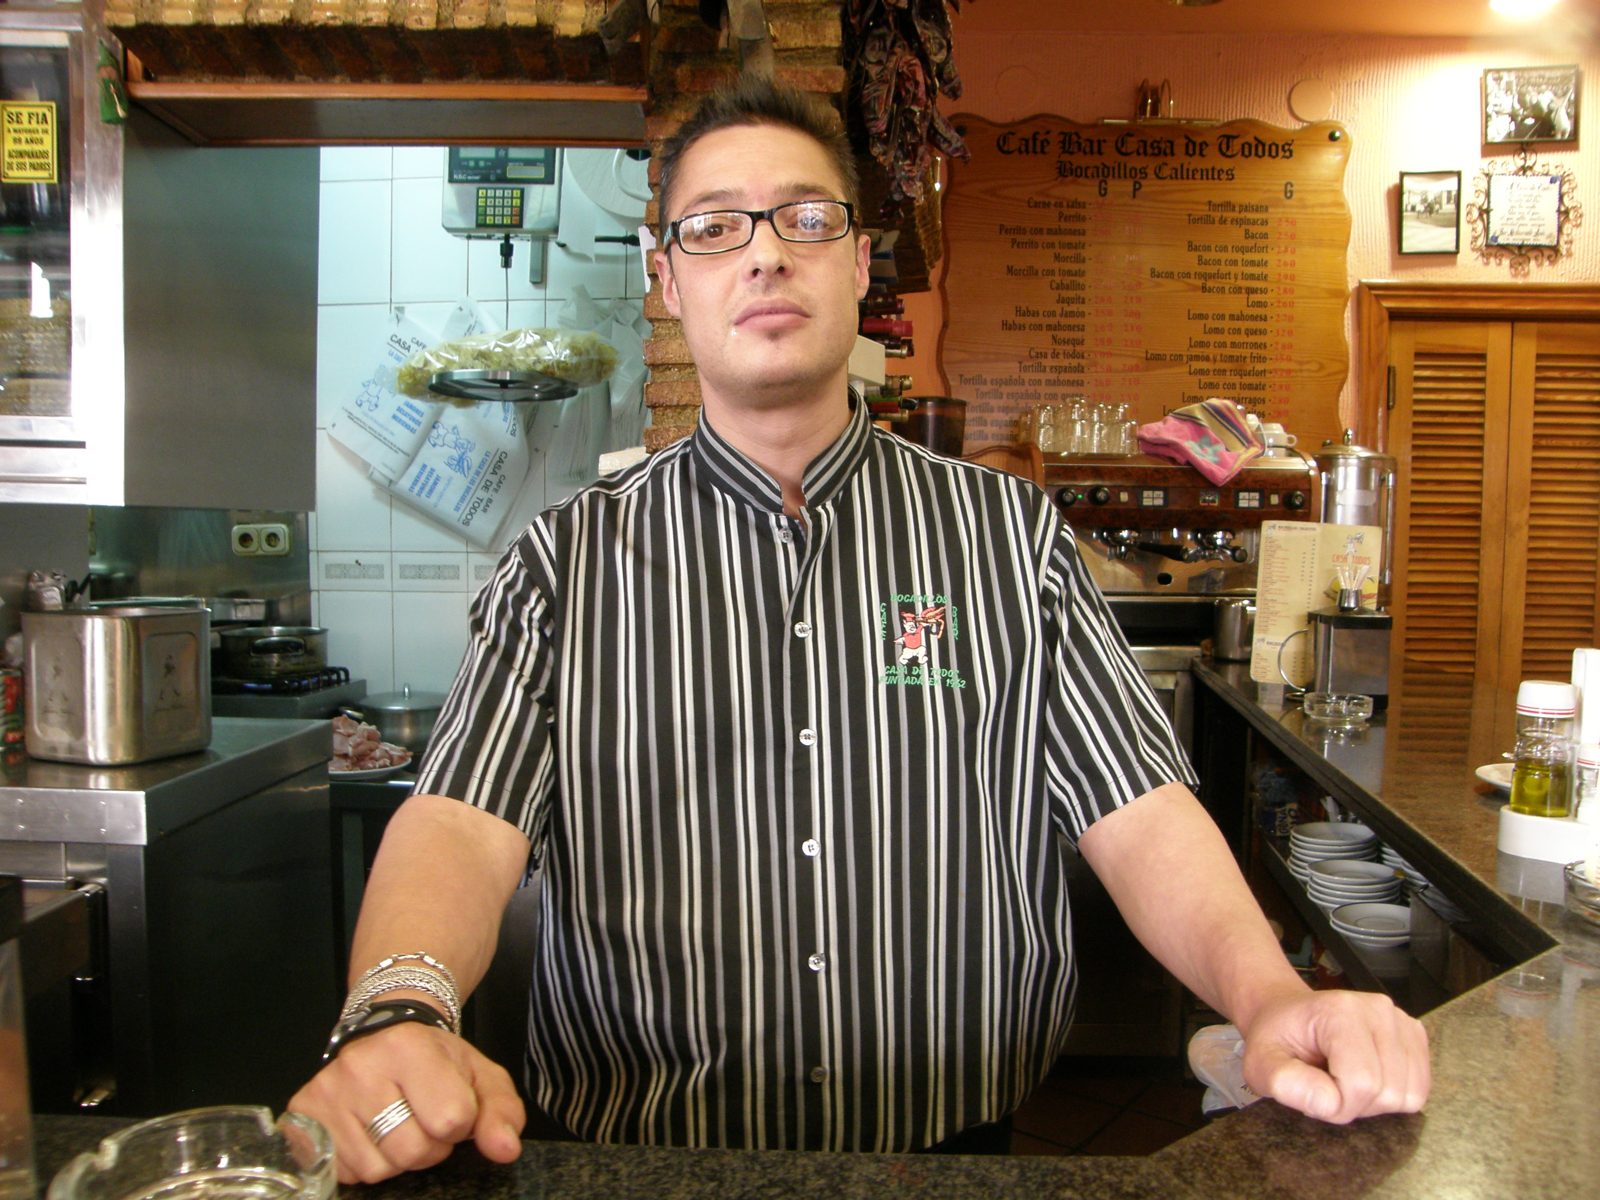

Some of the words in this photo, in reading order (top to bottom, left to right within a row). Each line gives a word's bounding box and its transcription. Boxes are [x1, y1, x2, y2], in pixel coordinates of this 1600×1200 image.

[7, 111, 23, 125] SE
[27, 111, 49, 125] FIA
[996, 130, 1051, 156] Café
[1058, 131, 1107, 158] Bar
[1115, 131, 1175, 158] Casa
[1184, 134, 1209, 158] de
[1217, 133, 1295, 160] Todos
[1056, 158, 1149, 181] Bocadillos
[1154, 161, 1236, 182] Calientes
[1098, 181, 1108, 198] G
[1133, 180, 1143, 199] P
[1284, 182, 1294, 199] G
[1027, 197, 1051, 208] Carne
[1066, 198, 1087, 209] salsa
[1207, 200, 1236, 212] Tortilla
[1239, 201, 1269, 214] paisana
[1058, 211, 1087, 223] Perrito
[1187, 213, 1216, 225] Tortilla
[1218, 214, 1228, 225] de
[1230, 215, 1268, 227] espinacas
[999, 224, 1027, 236] Perrito
[1029, 226, 1044, 236] con
[1047, 226, 1086, 237] mahonesa
[1244, 229, 1269, 240] Bacon
[1011, 238, 1039, 249] Perrito
[1041, 240, 1056, 250] con
[1058, 240, 1086, 250] tomate
[1187, 241, 1212, 252] Bacon
[1215, 244, 1229, 253] con
[1231, 243, 1268, 255] roquefort
[1053, 252, 1086, 264] Morcilla
[1197, 255, 1222, 266] Bacon
[1224, 258, 1239, 267] con
[1241, 257, 1268, 267] tomate
[1006, 264, 1039, 277] Morcilla
[1041, 267, 1056, 277] con
[1058, 267, 1086, 278] tomate
[1150, 268, 1175, 279] Bacon
[1177, 271, 1191, 279] con
[1194, 269, 1231, 282] roquefort
[1233, 272, 1239, 282] y
[1241, 271, 1268, 281] tomate
[1049, 279, 1086, 291] Caballito
[1201, 282, 1226, 294] Bacon
[1228, 285, 1242, 294] con
[1245, 285, 1268, 299] queso
[1056, 294, 1086, 306] Jaquita
[1246, 297, 1268, 308] Lomo
[1015, 306, 1040, 318] Habas
[1042, 309, 1056, 318] con
[1187, 308, 1209, 320] Lomo
[1212, 311, 1226, 321] con
[1228, 310, 1268, 322] mahonesa
[1001, 320, 1026, 331] Habas
[1029, 323, 1043, 332] con
[1046, 321, 1085, 332] mahonesa
[1203, 323, 1225, 335] Lomo
[1228, 326, 1242, 335] con
[1244, 327, 1267, 338] queso
[390, 334, 412, 353] CASA
[1189, 336, 1211, 349] Lomo
[1213, 340, 1228, 349] con
[1230, 339, 1267, 350] morrones
[1028, 347, 1048, 359] Casa
[1050, 348, 1060, 359] de
[1063, 349, 1085, 360] todos
[1145, 350, 1167, 361] Lomo
[1169, 353, 1184, 362] con
[1220, 353, 1248, 363] tomate
[1250, 351, 1267, 363] frito
[1018, 361, 1046, 373] Tortilla
[1049, 362, 1084, 374] española
[1188, 364, 1210, 376] Lomo
[1213, 367, 1227, 376] con
[1229, 365, 1266, 378] roquefort
[959, 374, 988, 386] Tortilla
[990, 375, 1025, 388] española
[1028, 377, 1042, 386] con
[1044, 375, 1084, 387] mahonesa
[1198, 378, 1220, 390] Lomo
[1222, 382, 1237, 390] con
[1239, 381, 1266, 391] tomate
[975, 388, 1003, 400] Tortilla
[1006, 389, 1041, 402] española
[1044, 391, 1058, 401] con
[1182, 392, 1201, 403] Lomo
[964, 416, 989, 427] ortilla
[964, 430, 989, 441] ortilla
[491, 450, 508, 476] CASA
[481, 479, 493, 493] DE
[462, 496, 484, 526] TODOS
[890, 594, 948, 604] BOCADILLOS
[885, 665, 907, 675] CASA
